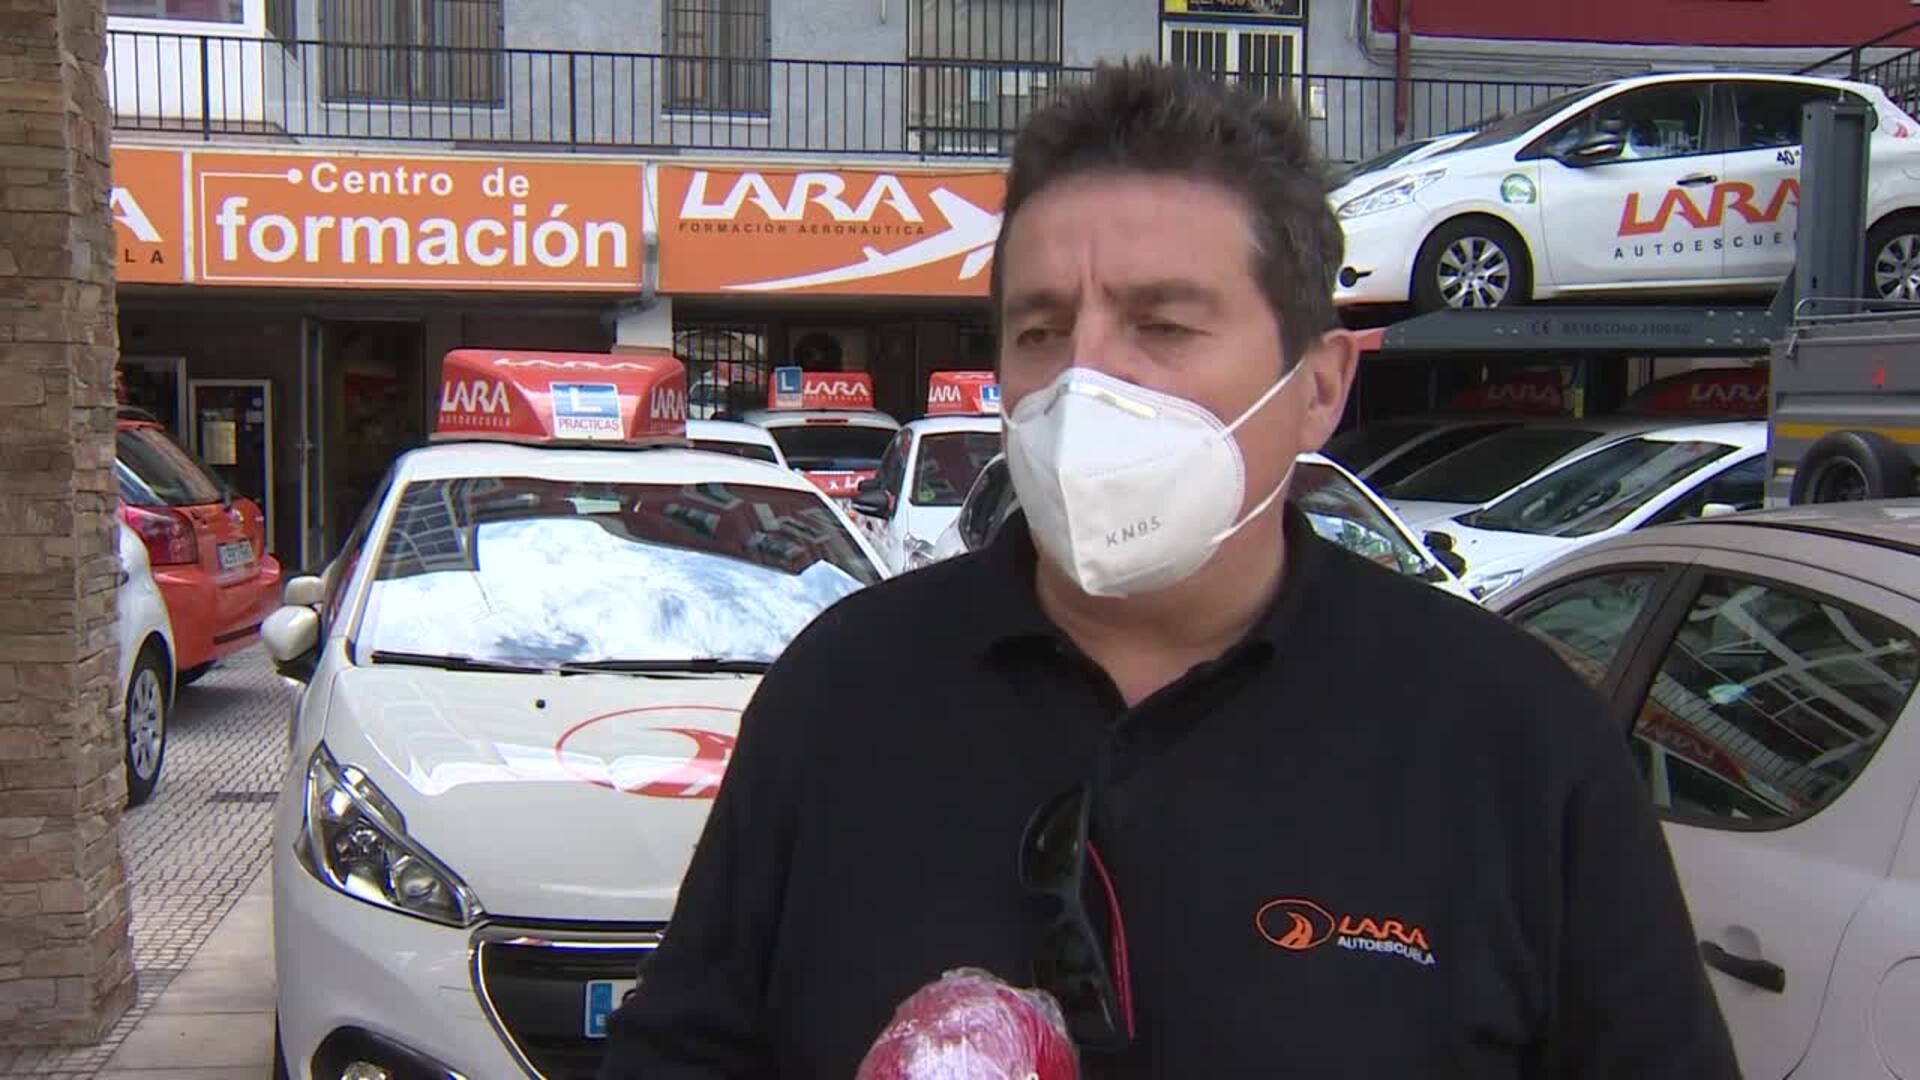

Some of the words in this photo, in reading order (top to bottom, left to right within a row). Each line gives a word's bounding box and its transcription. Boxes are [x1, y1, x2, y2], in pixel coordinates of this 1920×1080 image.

[311, 162, 453, 195] Centro
[483, 168, 529, 197] de
[679, 171, 925, 222] LARA
[215, 196, 628, 268] formación
[441, 381, 511, 413] LARA
[803, 380, 868, 396] LARA
[928, 385, 961, 402] LARA
[1105, 516, 1161, 547] KN95
[1337, 915, 1430, 950] LARA
[1336, 936, 1436, 966] AUTOESCUELA
